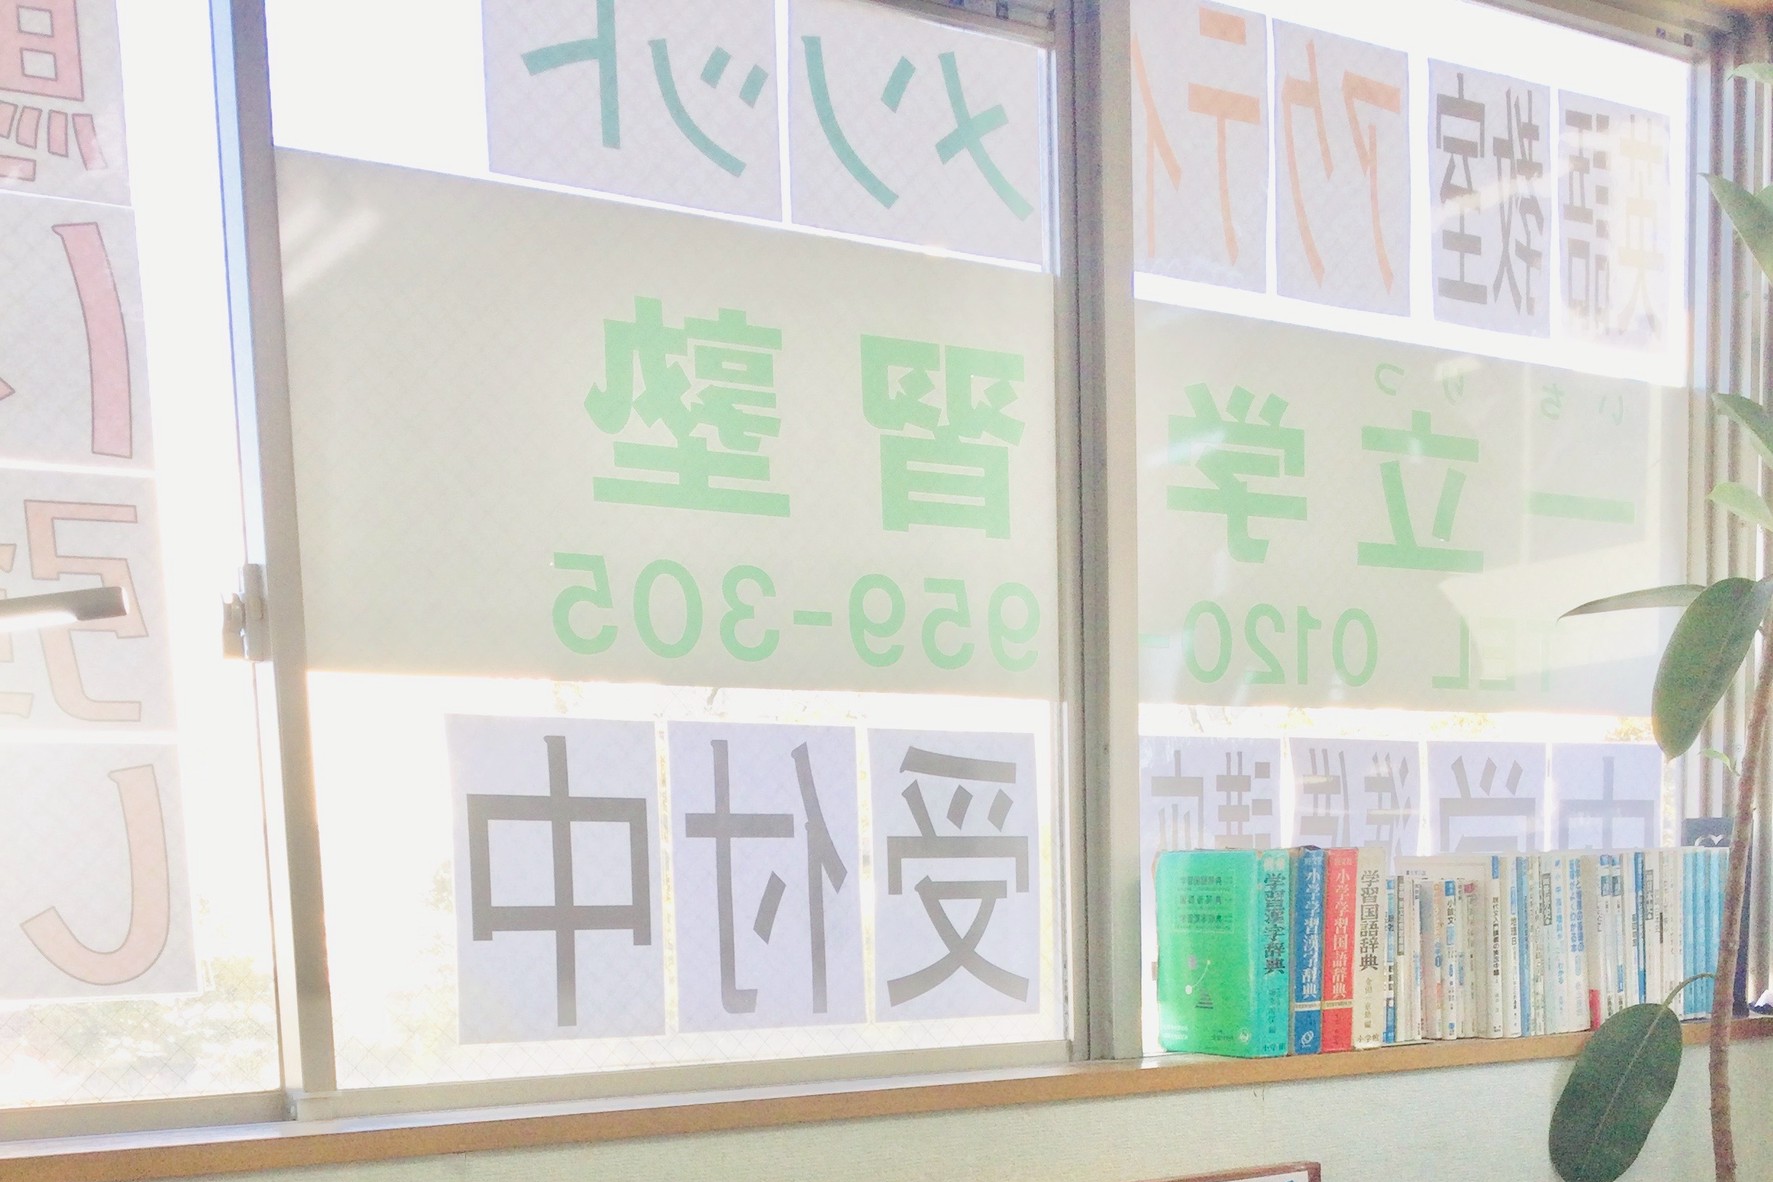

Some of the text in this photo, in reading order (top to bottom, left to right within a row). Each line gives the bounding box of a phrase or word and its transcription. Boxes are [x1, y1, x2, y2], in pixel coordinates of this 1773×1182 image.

[1263, 872, 1287, 976] 学習漢字辞典
[1358, 869, 1380, 972] 学習国語辞典
